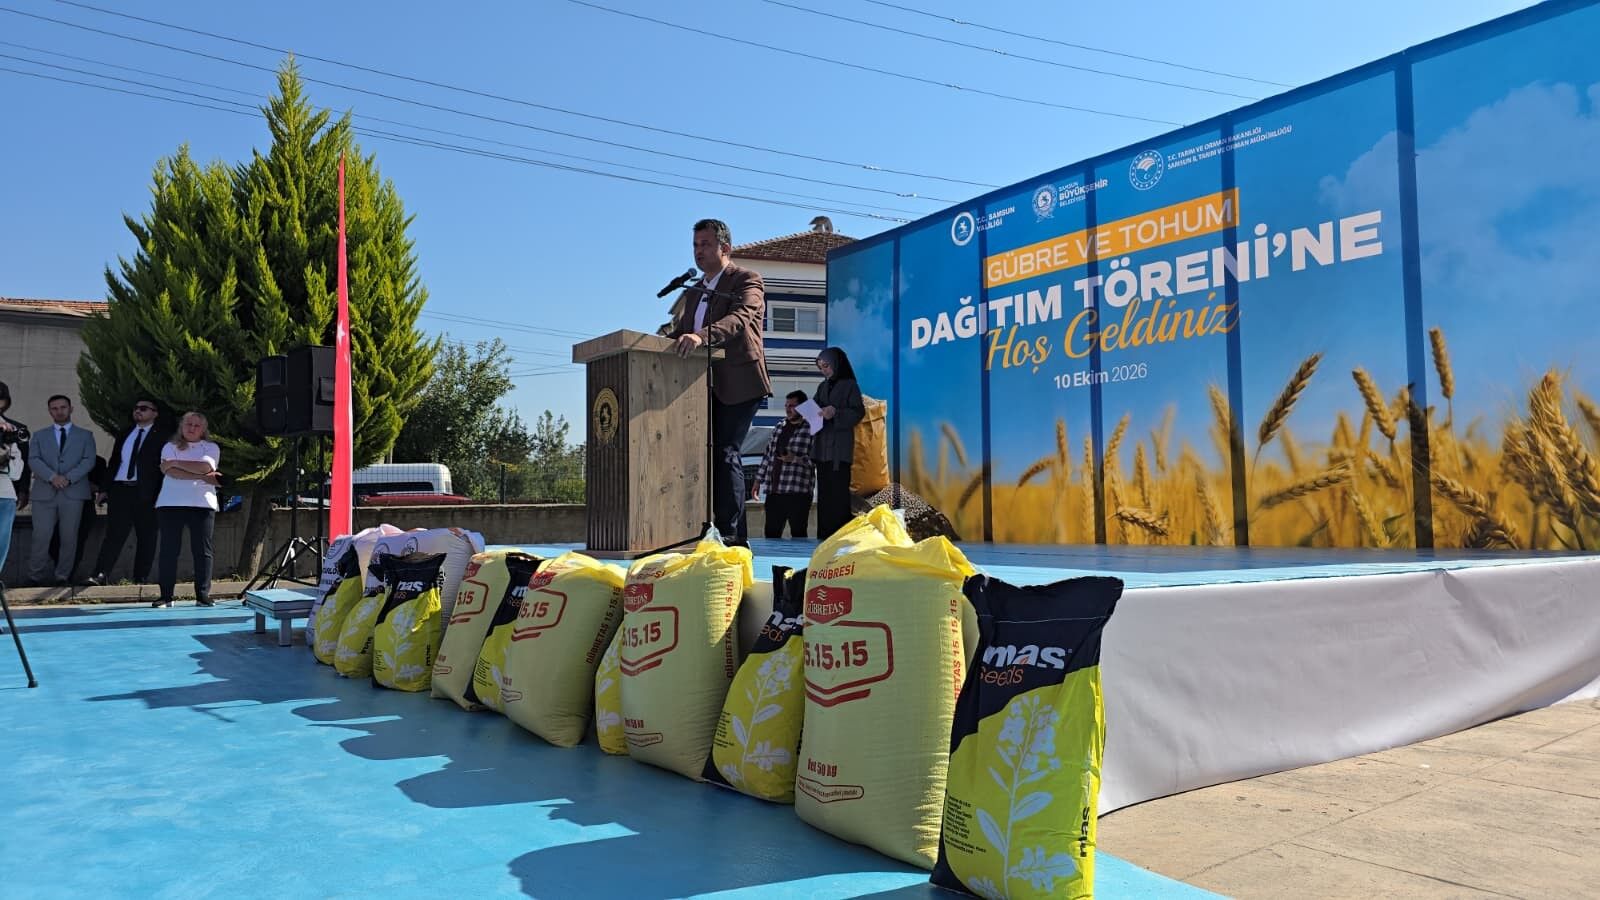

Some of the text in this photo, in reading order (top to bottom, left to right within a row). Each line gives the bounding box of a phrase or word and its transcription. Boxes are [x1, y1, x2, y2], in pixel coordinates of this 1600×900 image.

[1168, 157, 1192, 170] SAMSUN
[1199, 149, 1217, 161] TARIM
[1217, 147, 1226, 155] VE
[1226, 140, 1249, 152] ORMAN
[1178, 148, 1196, 159] TARIM
[1196, 145, 1204, 154] VE
[1204, 138, 1228, 150] ORMAN
[1059, 178, 1109, 201] BÜYÜKŞEHİR
[976, 206, 1016, 225] T.C. SAMSUN
[987, 198, 1233, 282] GÜBRE VE TOHUM
[911, 284, 1063, 349] DAĞITIM
[984, 292, 1243, 374] Hoş Geldiniz
[1054, 363, 1148, 389] 10 Ekim 2026
[818, 561, 856, 580] GÜBRESİ
[982, 644, 1066, 669] mas
[817, 763, 826, 777] 50
